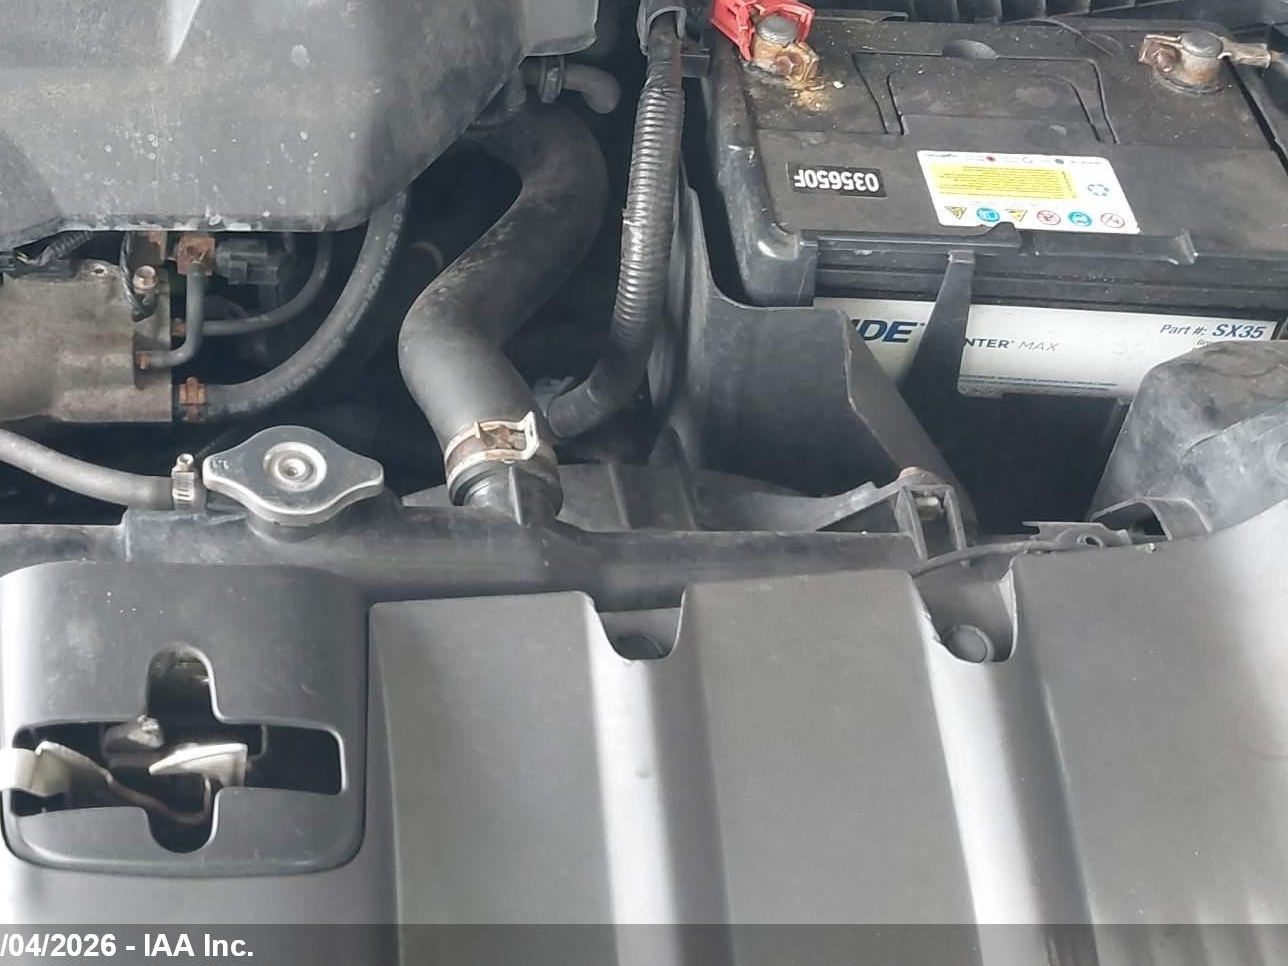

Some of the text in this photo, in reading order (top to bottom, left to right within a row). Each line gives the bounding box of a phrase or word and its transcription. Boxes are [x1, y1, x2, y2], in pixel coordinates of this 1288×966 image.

[794, 168, 880, 193] 035650F
[1160, 323, 1267, 339] Part #: SX35
[1019, 340, 1059, 352] MAX
